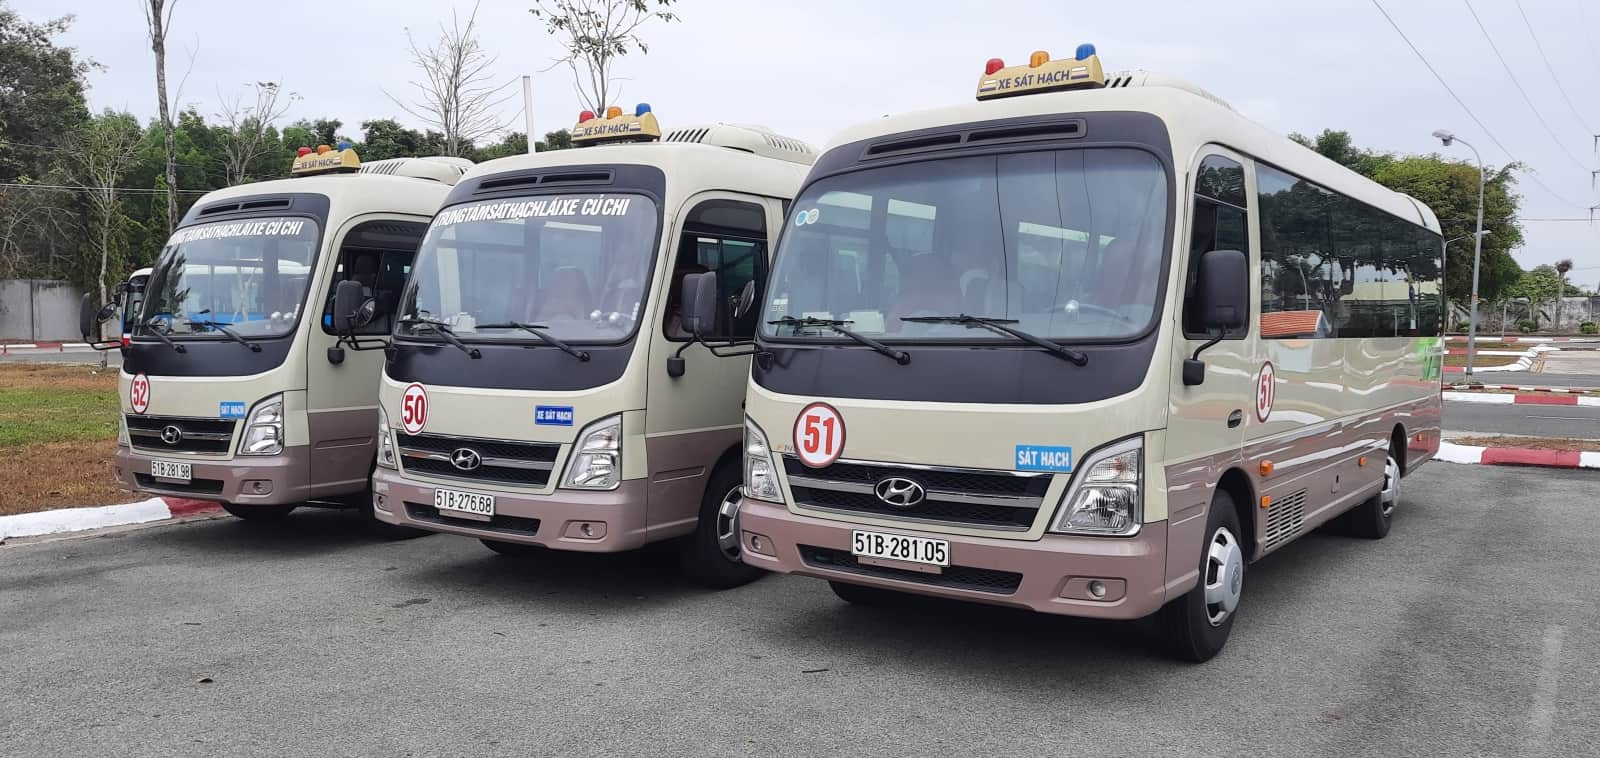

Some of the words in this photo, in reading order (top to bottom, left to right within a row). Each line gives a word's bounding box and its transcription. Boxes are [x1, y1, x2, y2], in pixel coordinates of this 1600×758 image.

[997, 79, 1011, 90] XE
[1014, 73, 1034, 88] SÁT
[1037, 70, 1070, 85] HẠCH
[583, 127, 592, 136] XE
[593, 125, 607, 135] SÁT
[607, 123, 630, 135] HẠCH
[602, 198, 631, 216] CHI
[133, 380, 146, 406] 52
[1260, 373, 1272, 410] 51
[403, 394, 425, 425] 50
[803, 414, 835, 455] 51
[152, 461, 190, 478] 51B-281.98
[1018, 447, 1038, 466] SÁT
[1040, 450, 1070, 470] HẠCH
[435, 490, 492, 513] 51B-276.68
[855, 532, 946, 563] 51B-281.05
